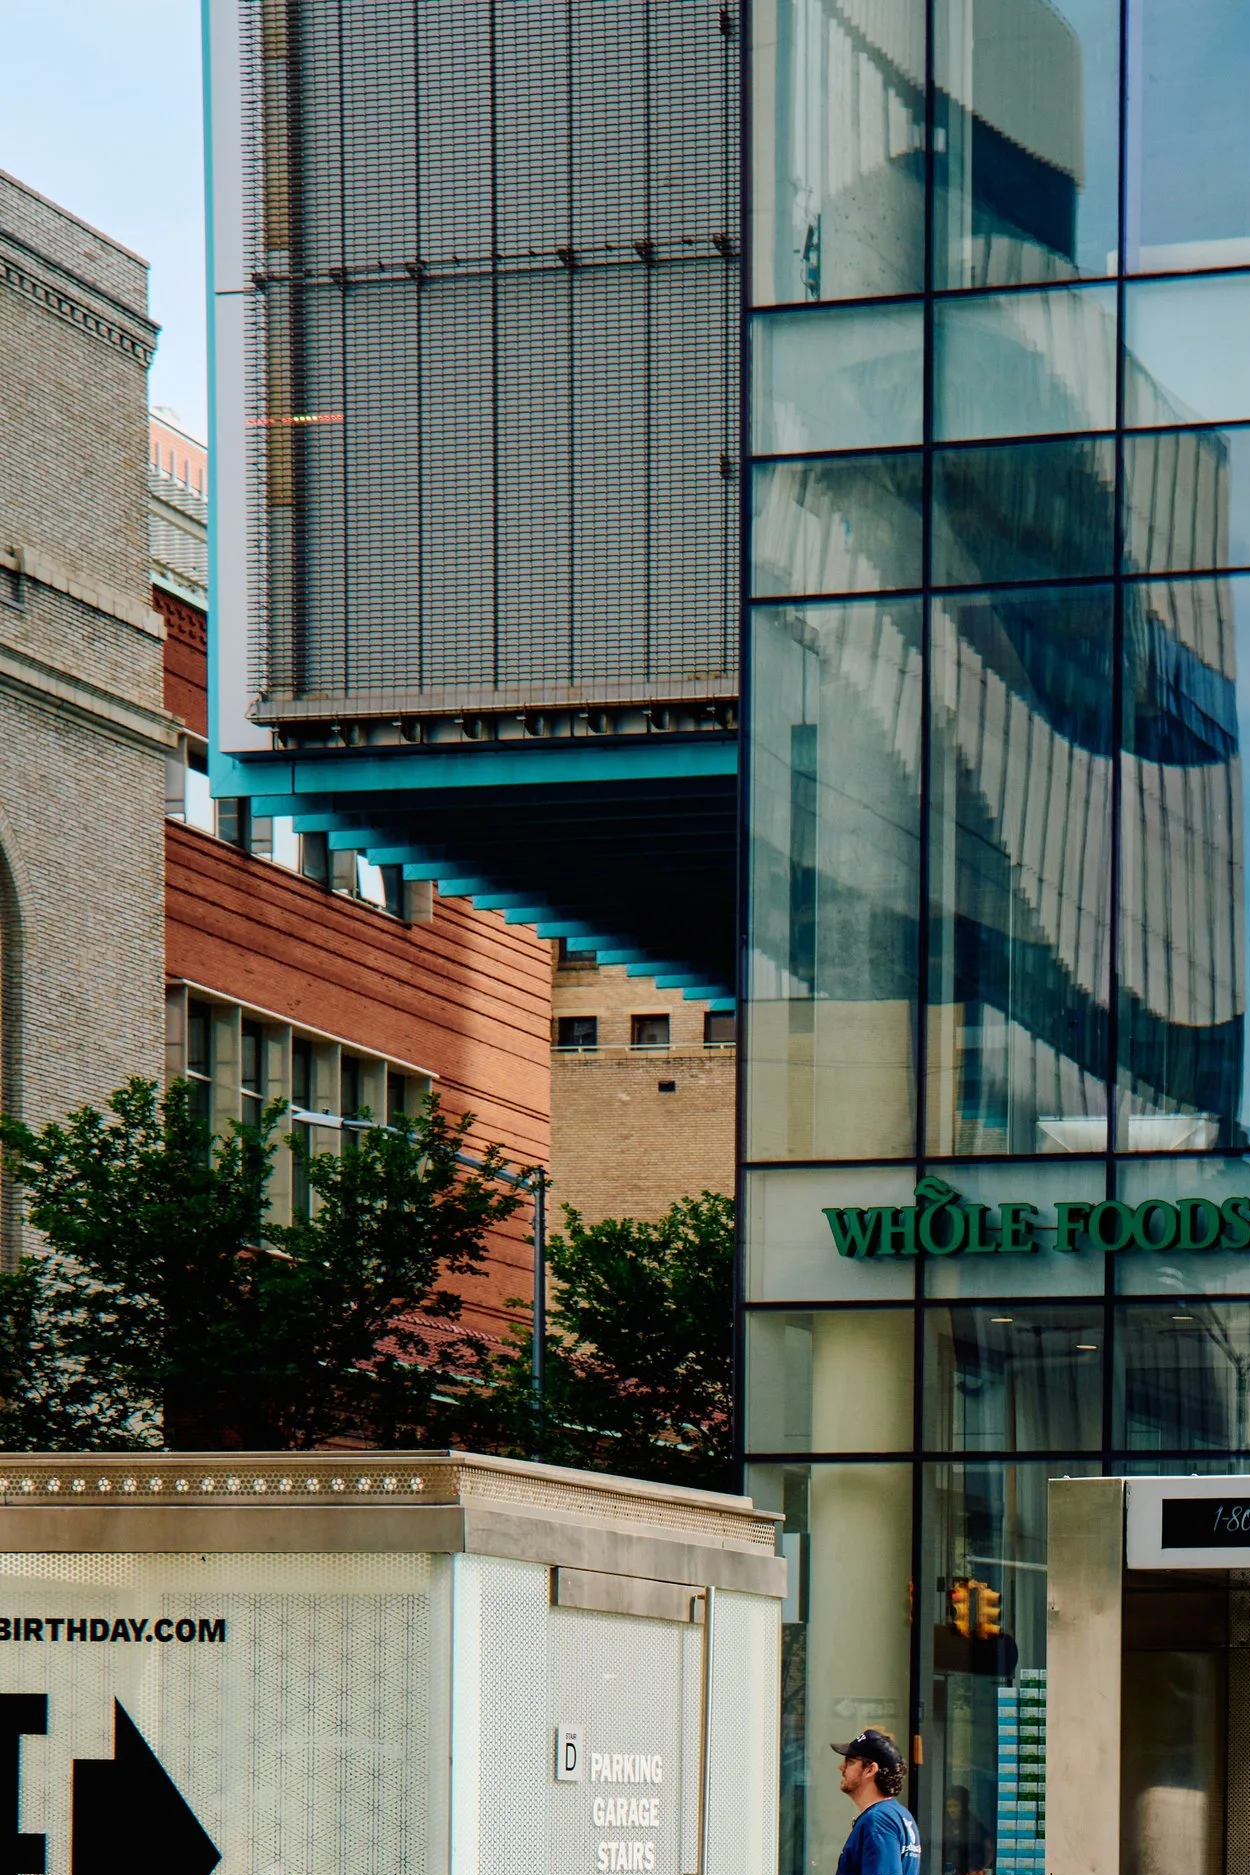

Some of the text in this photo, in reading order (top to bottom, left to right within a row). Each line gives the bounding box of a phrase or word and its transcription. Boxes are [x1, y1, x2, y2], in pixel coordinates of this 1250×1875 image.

[822, 1177, 1039, 1258] WHOLE
[0, 1618, 226, 1643] BIRTHDAY.COM
[565, 1732, 577, 1740] STAIR
[565, 1742, 577, 1772] D
[591, 1752, 663, 1784] PARKING
[592, 1797, 660, 1828] GARAGE
[597, 1841, 656, 1871] STAIRS
